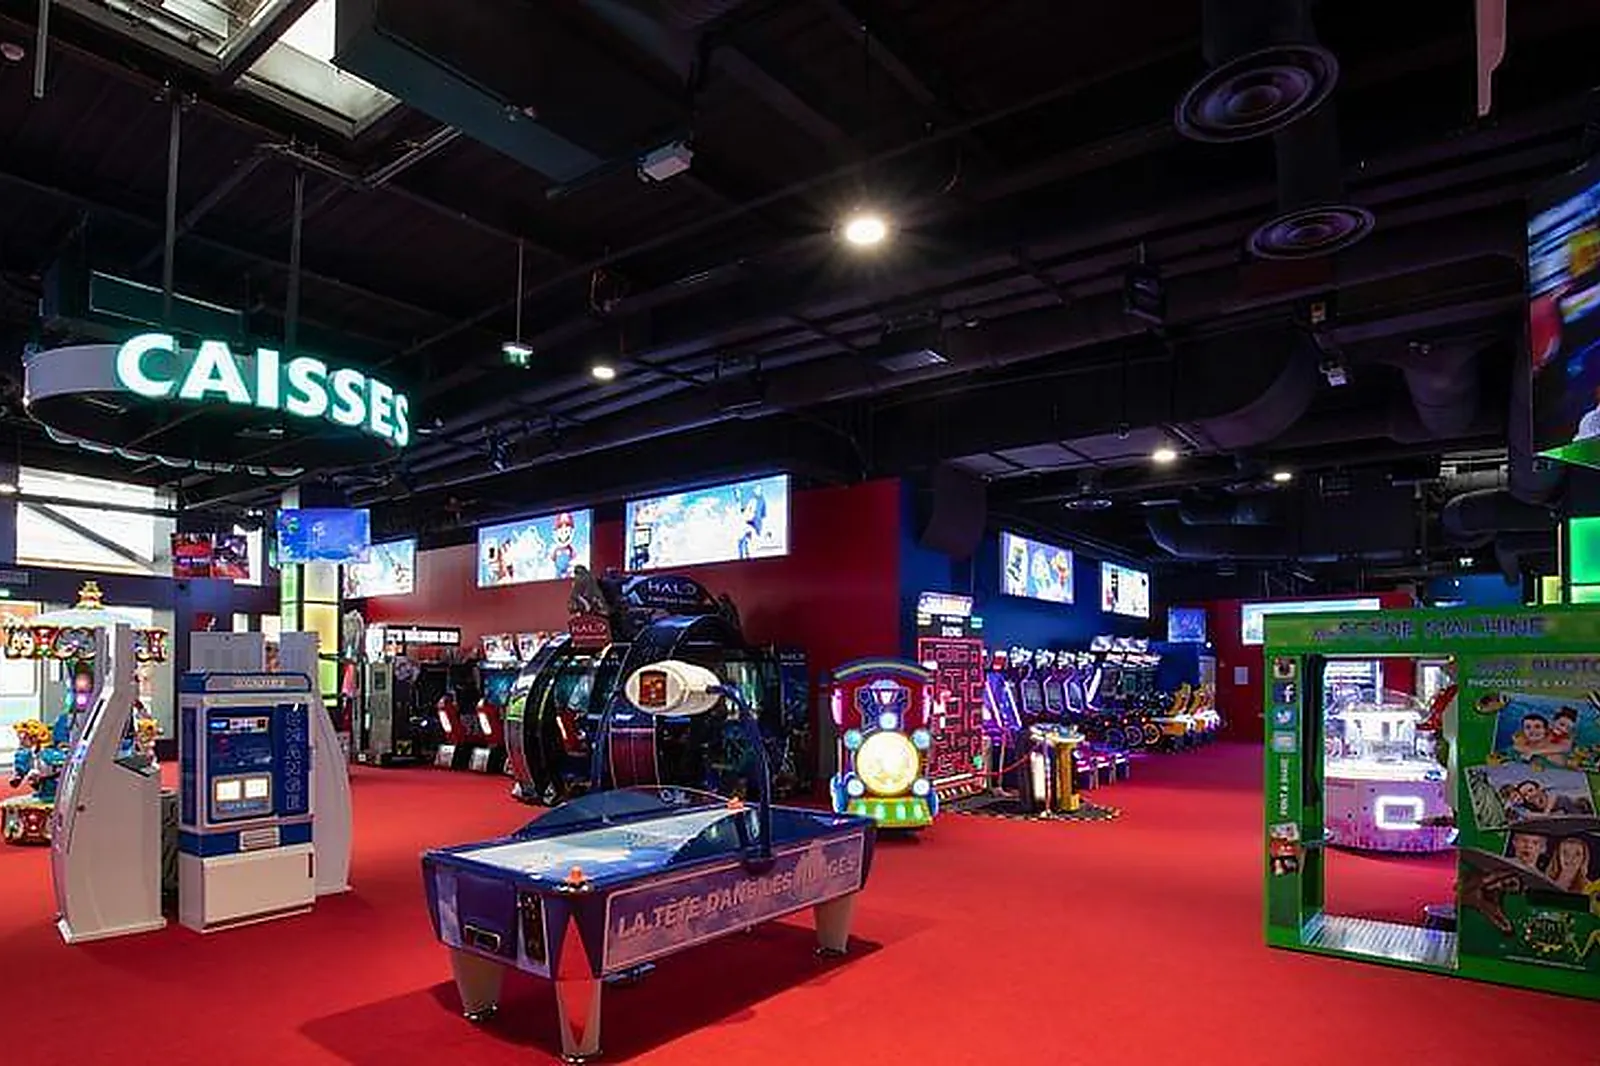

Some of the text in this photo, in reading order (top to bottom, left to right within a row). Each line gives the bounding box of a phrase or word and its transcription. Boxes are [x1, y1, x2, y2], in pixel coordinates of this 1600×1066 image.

[116, 333, 409, 447] CAISSES
[648, 580, 697, 594] HALO
[618, 911, 647, 938] LA
[797, 856, 858, 889] NUGES
